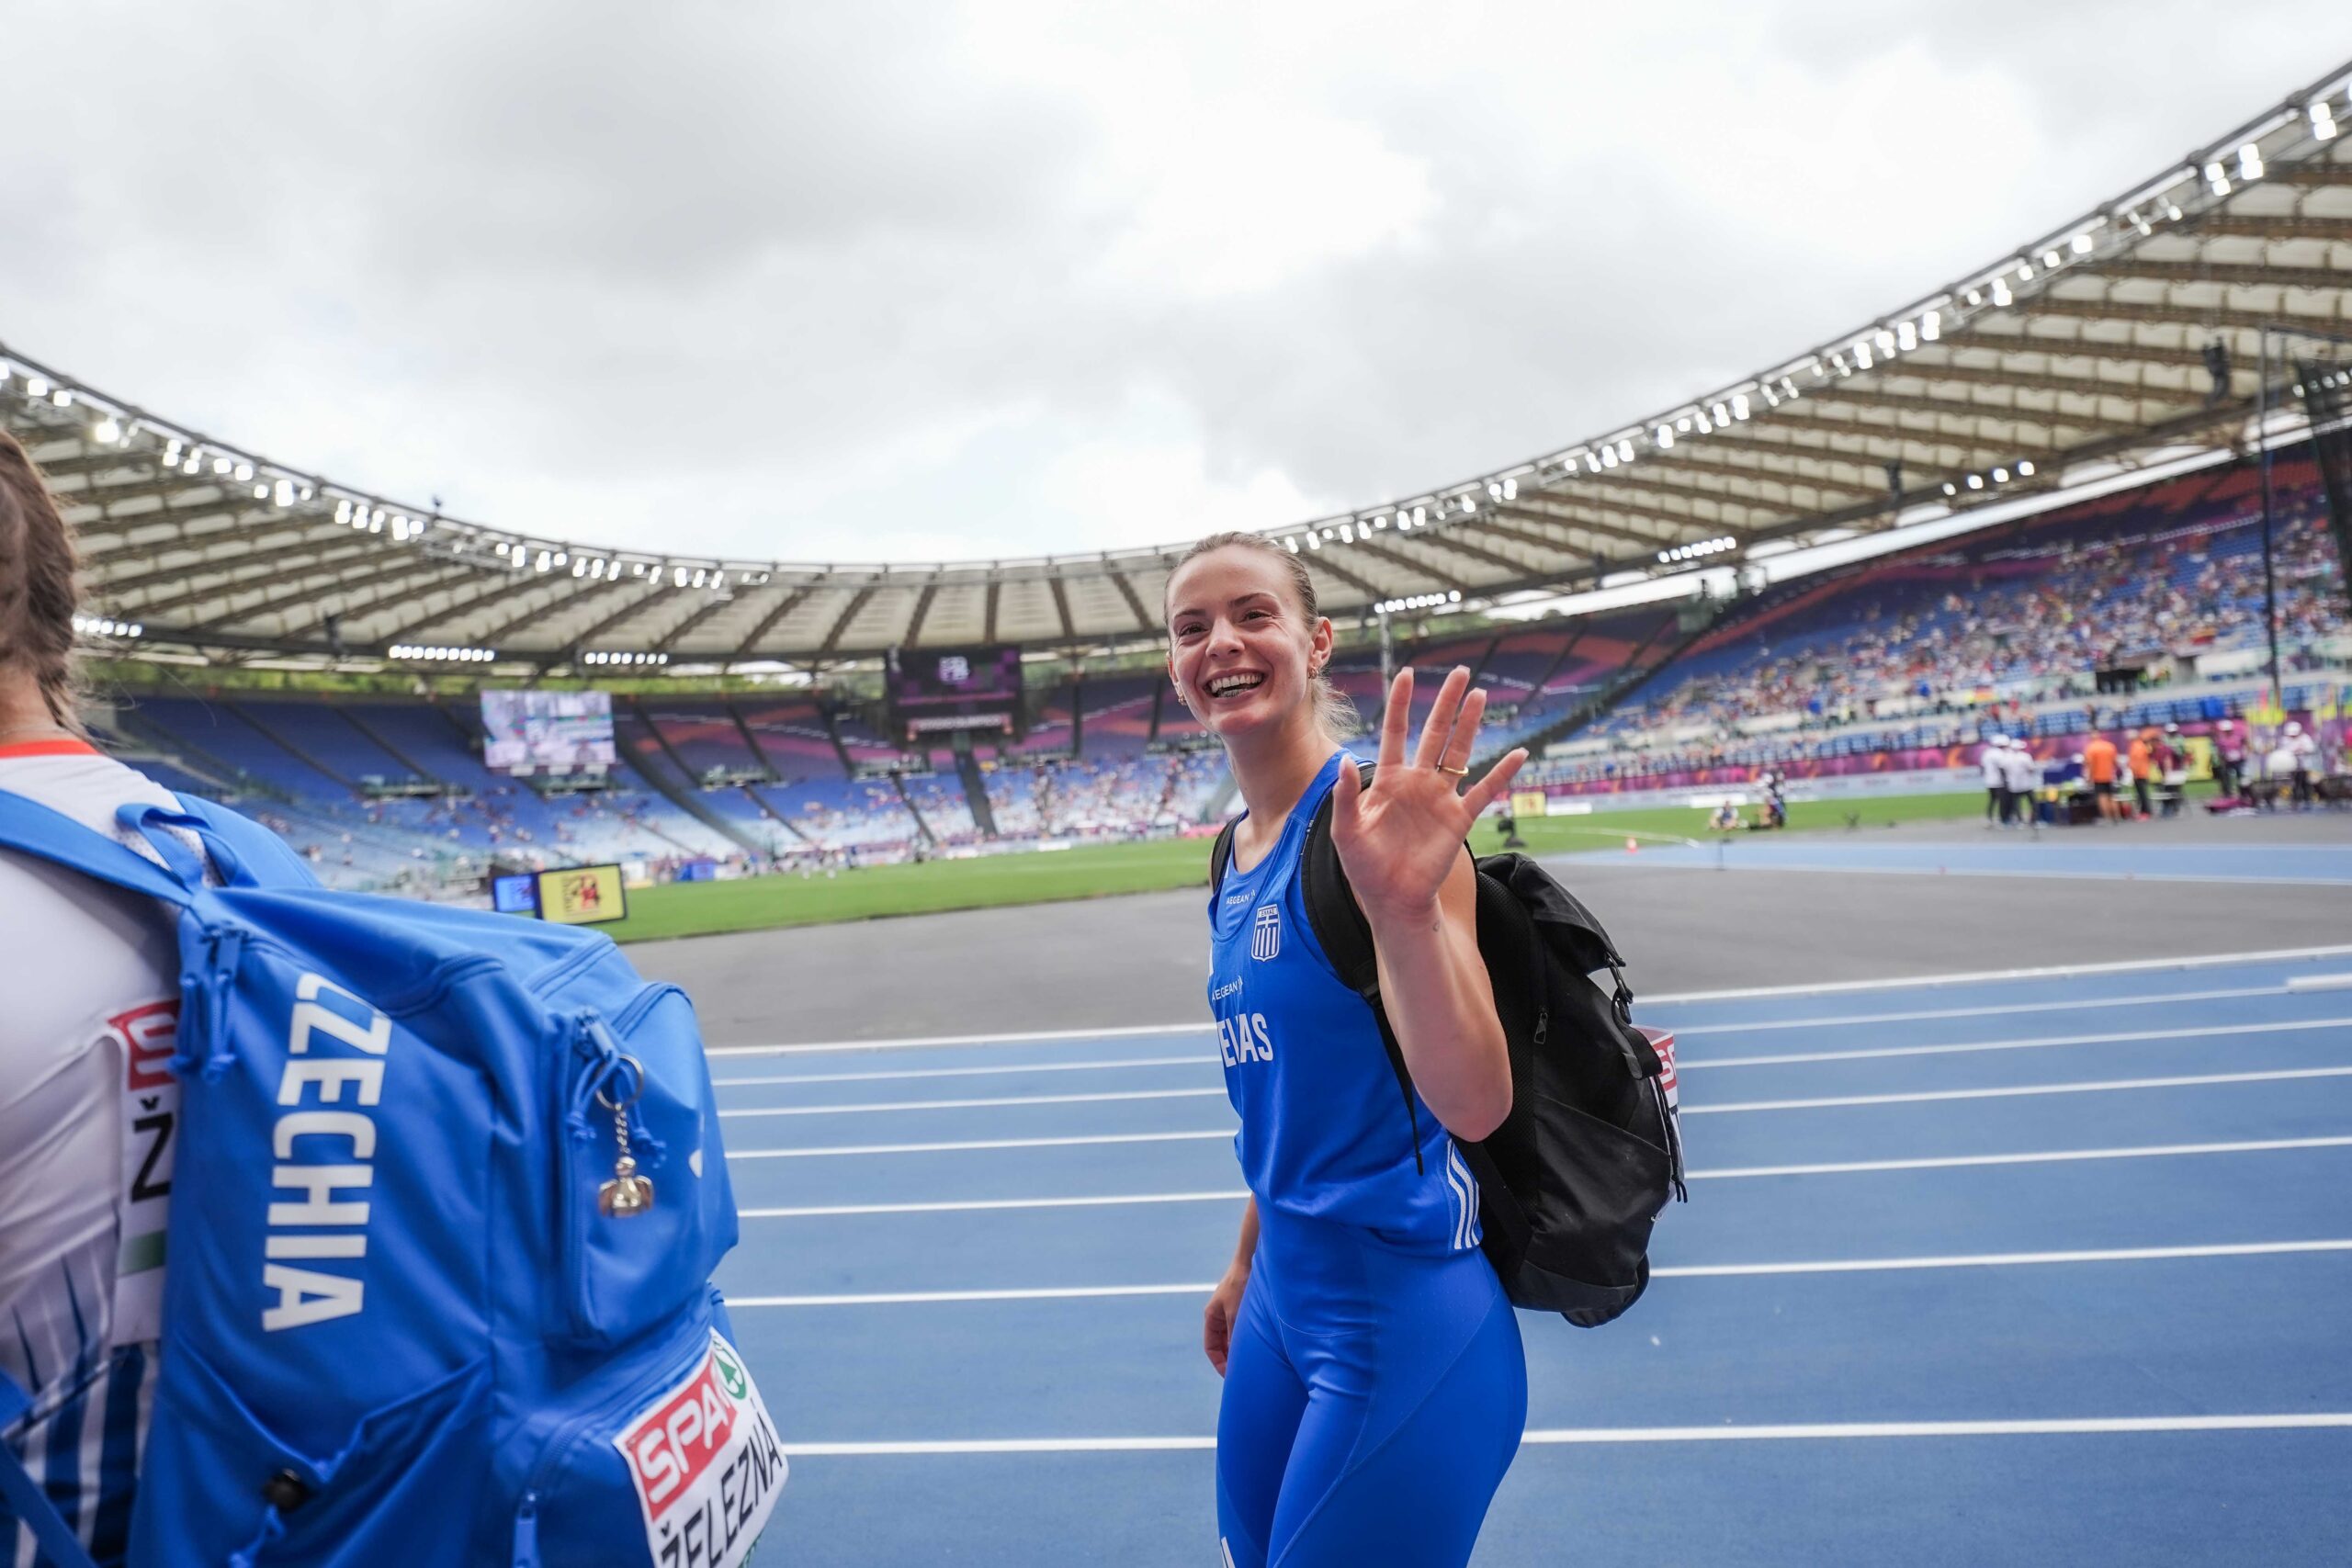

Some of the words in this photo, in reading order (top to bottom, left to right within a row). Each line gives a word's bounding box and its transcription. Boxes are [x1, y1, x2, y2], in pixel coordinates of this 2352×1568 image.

[1226, 894, 1250, 905] AEGEAN
[1211, 979, 1238, 1001] AEGEAN
[637, 1363, 732, 1506] SPA
